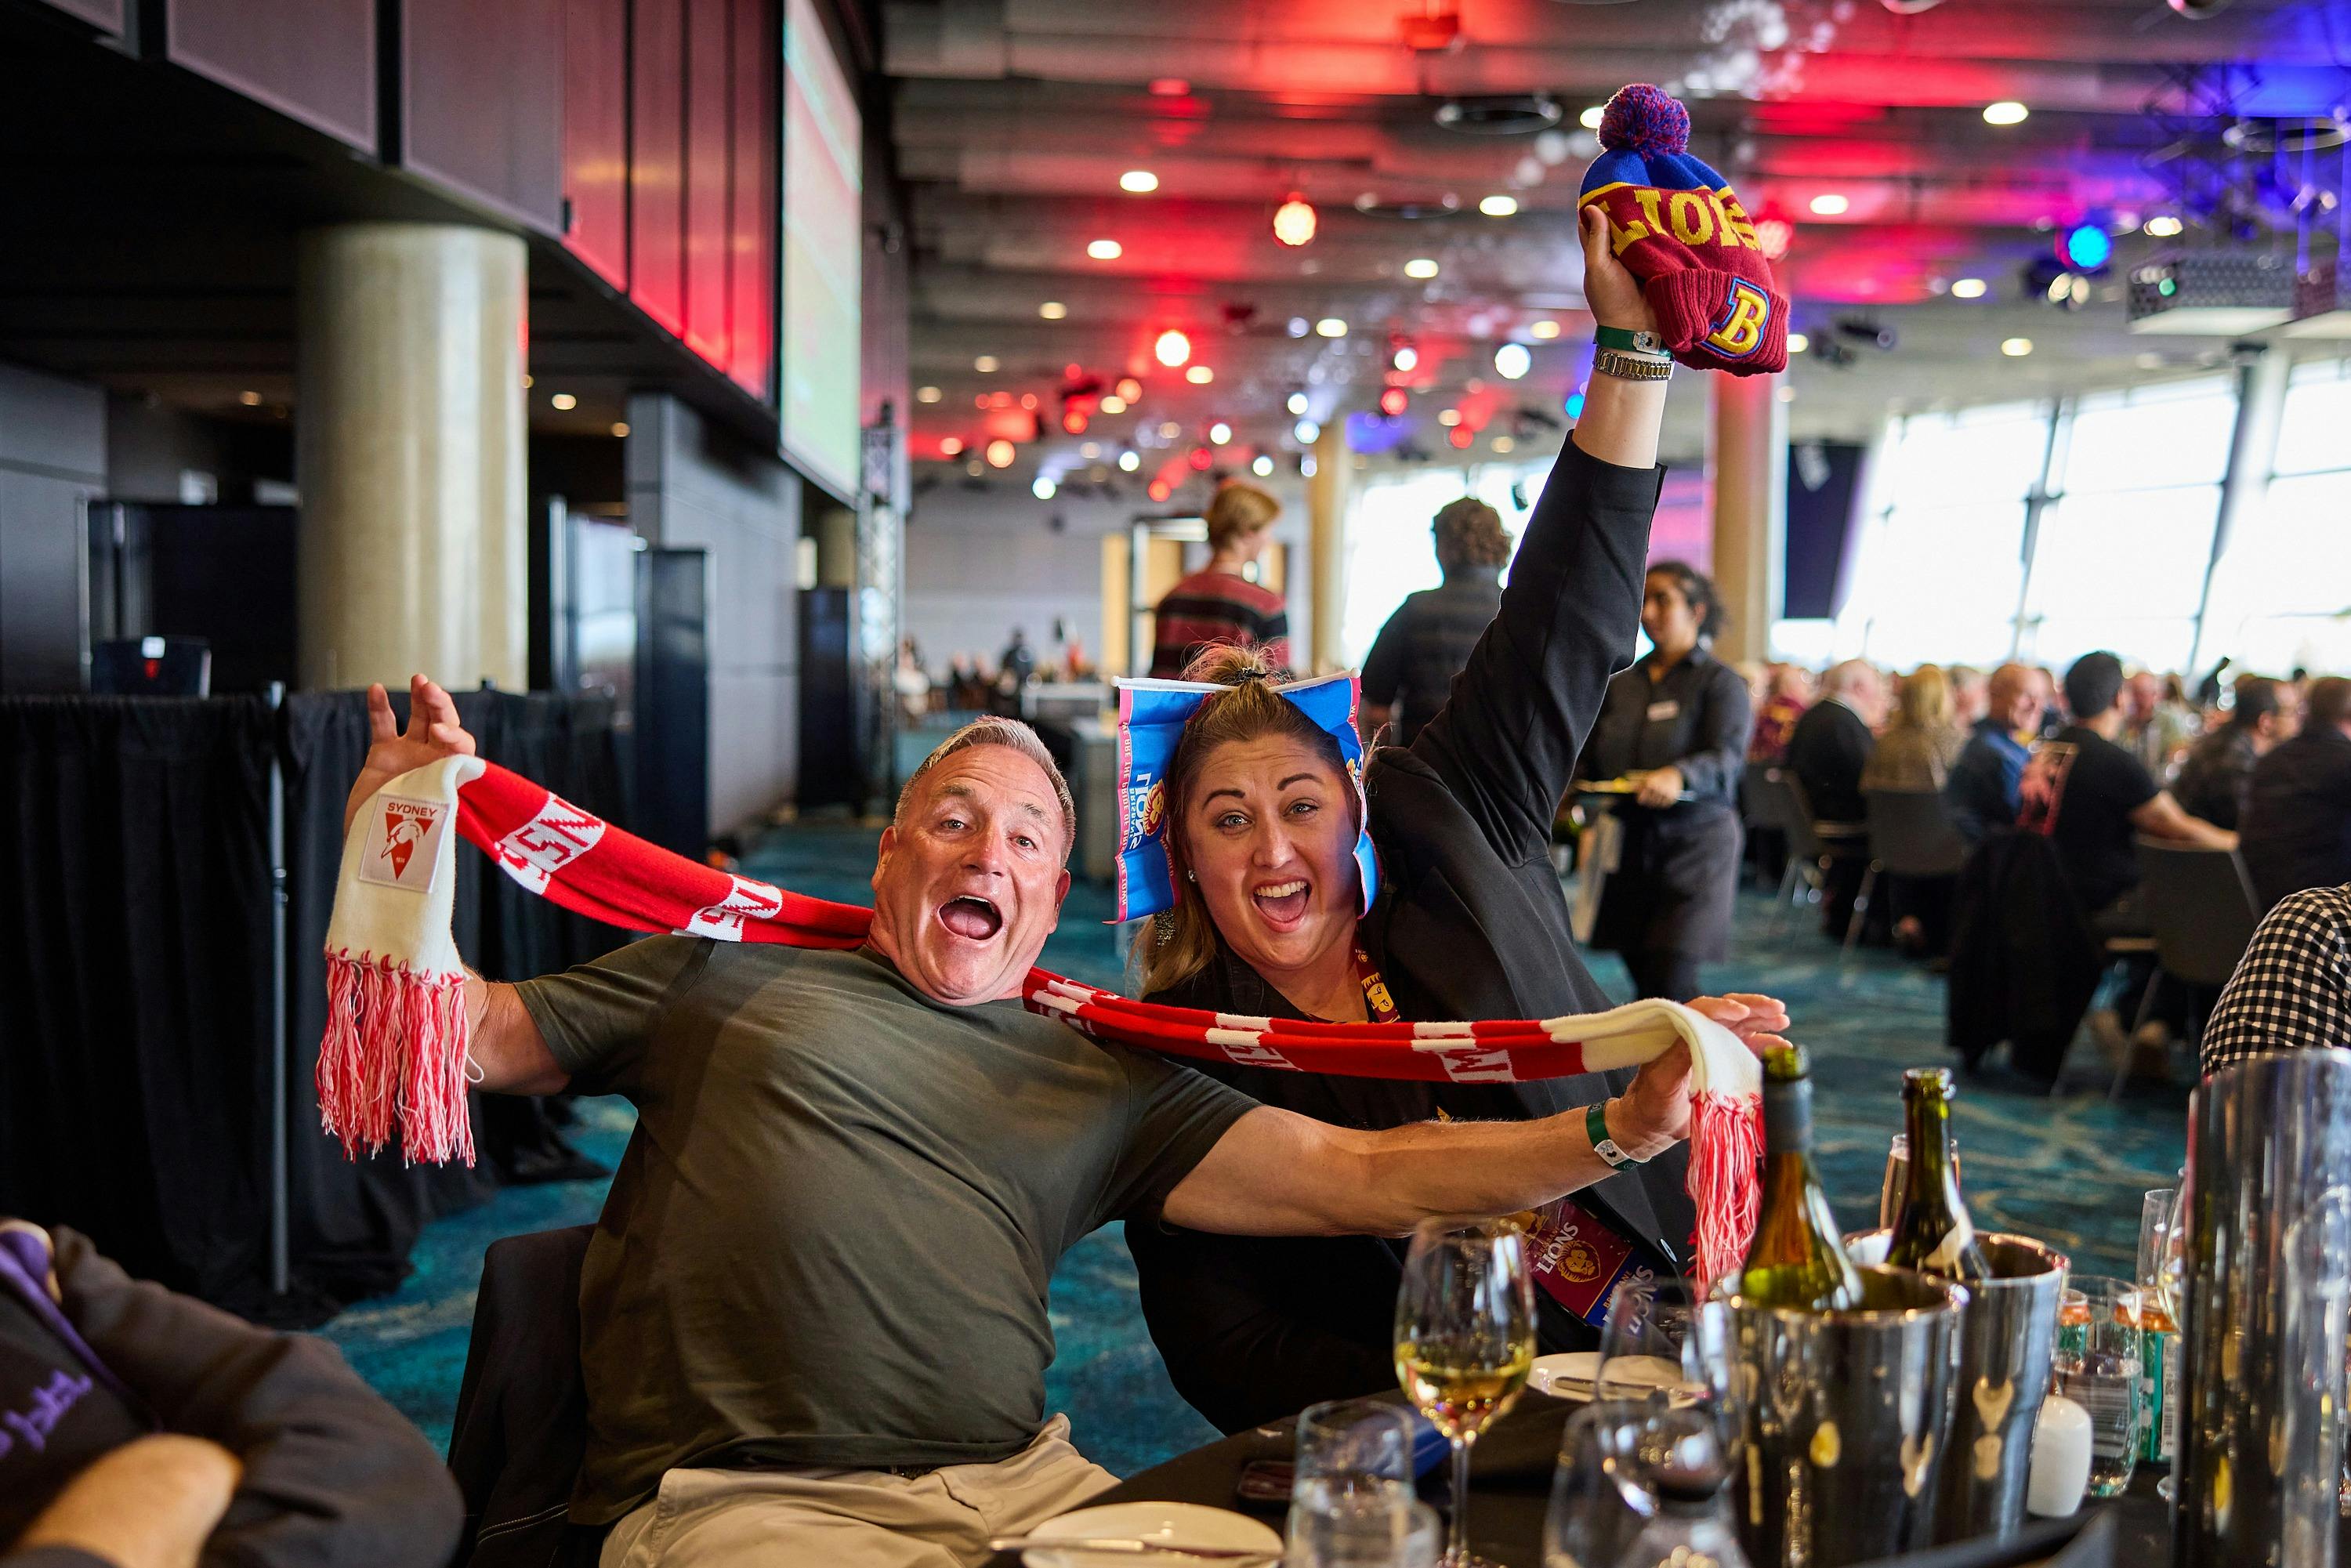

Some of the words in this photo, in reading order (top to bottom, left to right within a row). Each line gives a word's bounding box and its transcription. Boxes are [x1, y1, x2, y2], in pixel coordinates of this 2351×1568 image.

[1706, 284, 1770, 356] B
[387, 802, 438, 817] SYDNEY
[1536, 1222, 1579, 1274] LIONS
[1603, 1270, 1634, 1309] BRANE
